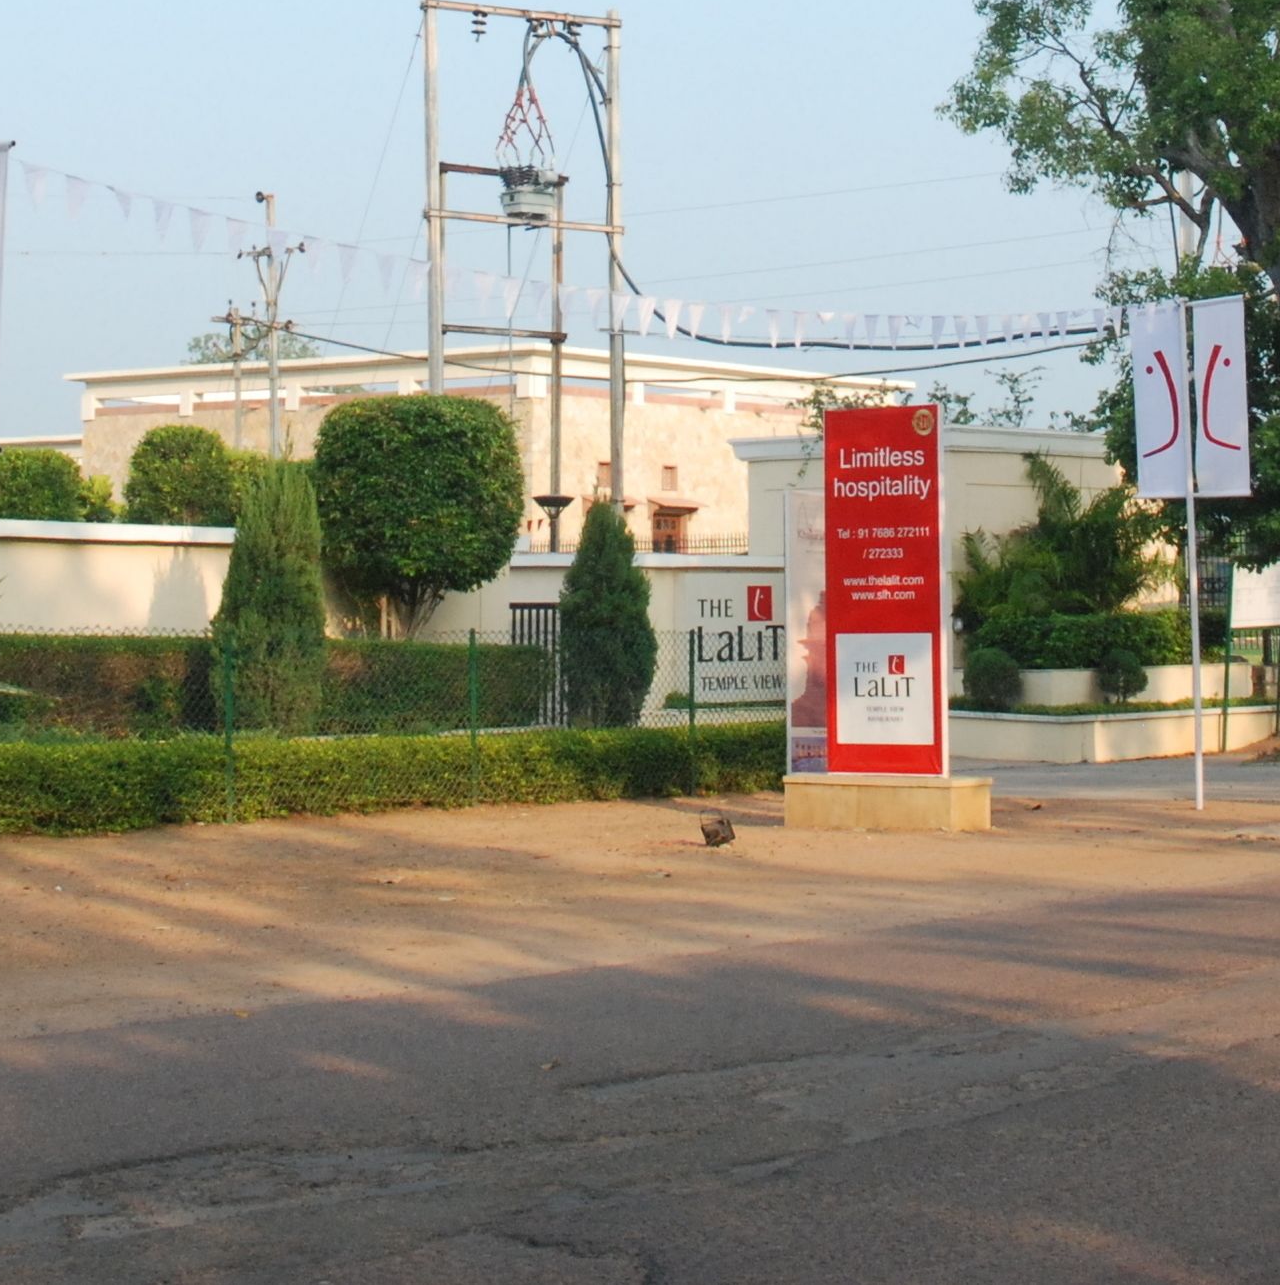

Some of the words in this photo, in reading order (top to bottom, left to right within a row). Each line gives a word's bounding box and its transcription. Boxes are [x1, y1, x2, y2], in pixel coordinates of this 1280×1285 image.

[840, 446, 925, 469] Limitless
[834, 474, 931, 502] hospitality
[837, 528, 850, 539] Tel
[857, 528, 869, 539] 91
[872, 527, 895, 538] 7686
[897, 526, 930, 538] 272111
[868, 548, 904, 559] 272333
[843, 575, 925, 586] www.thelalit.com
[697, 599, 734, 618] THE
[854, 661, 879, 674] THE
[700, 675, 749, 692] TEMPLE
[753, 674, 784, 690] VIEW
